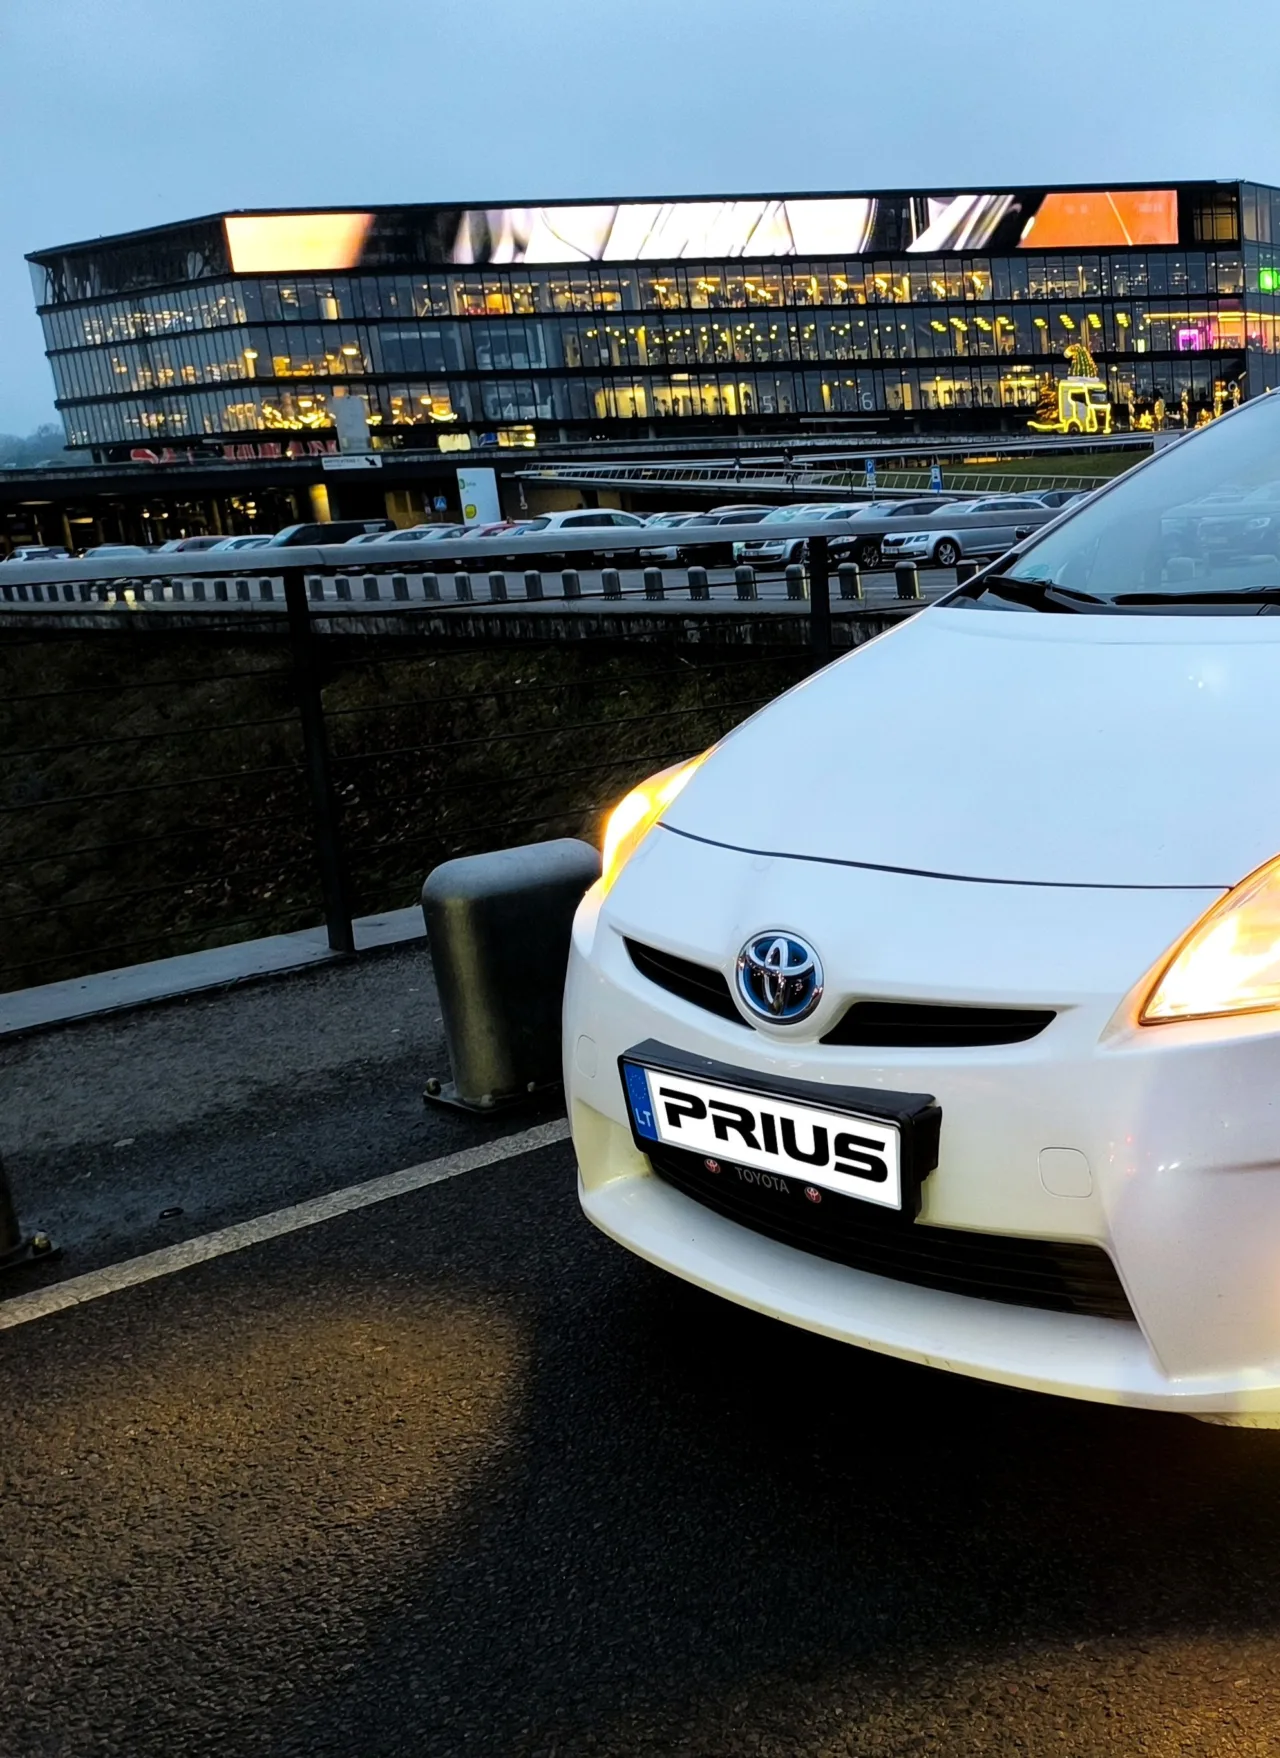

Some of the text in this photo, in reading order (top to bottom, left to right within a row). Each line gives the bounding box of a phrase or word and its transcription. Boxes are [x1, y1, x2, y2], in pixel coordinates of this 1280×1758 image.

[503, 402, 517, 420] 4
[861, 391, 874, 411] 6
[635, 1107, 651, 1128] LT
[659, 1086, 888, 1183] PRIUS
[735, 1165, 790, 1194] TOYOTA
